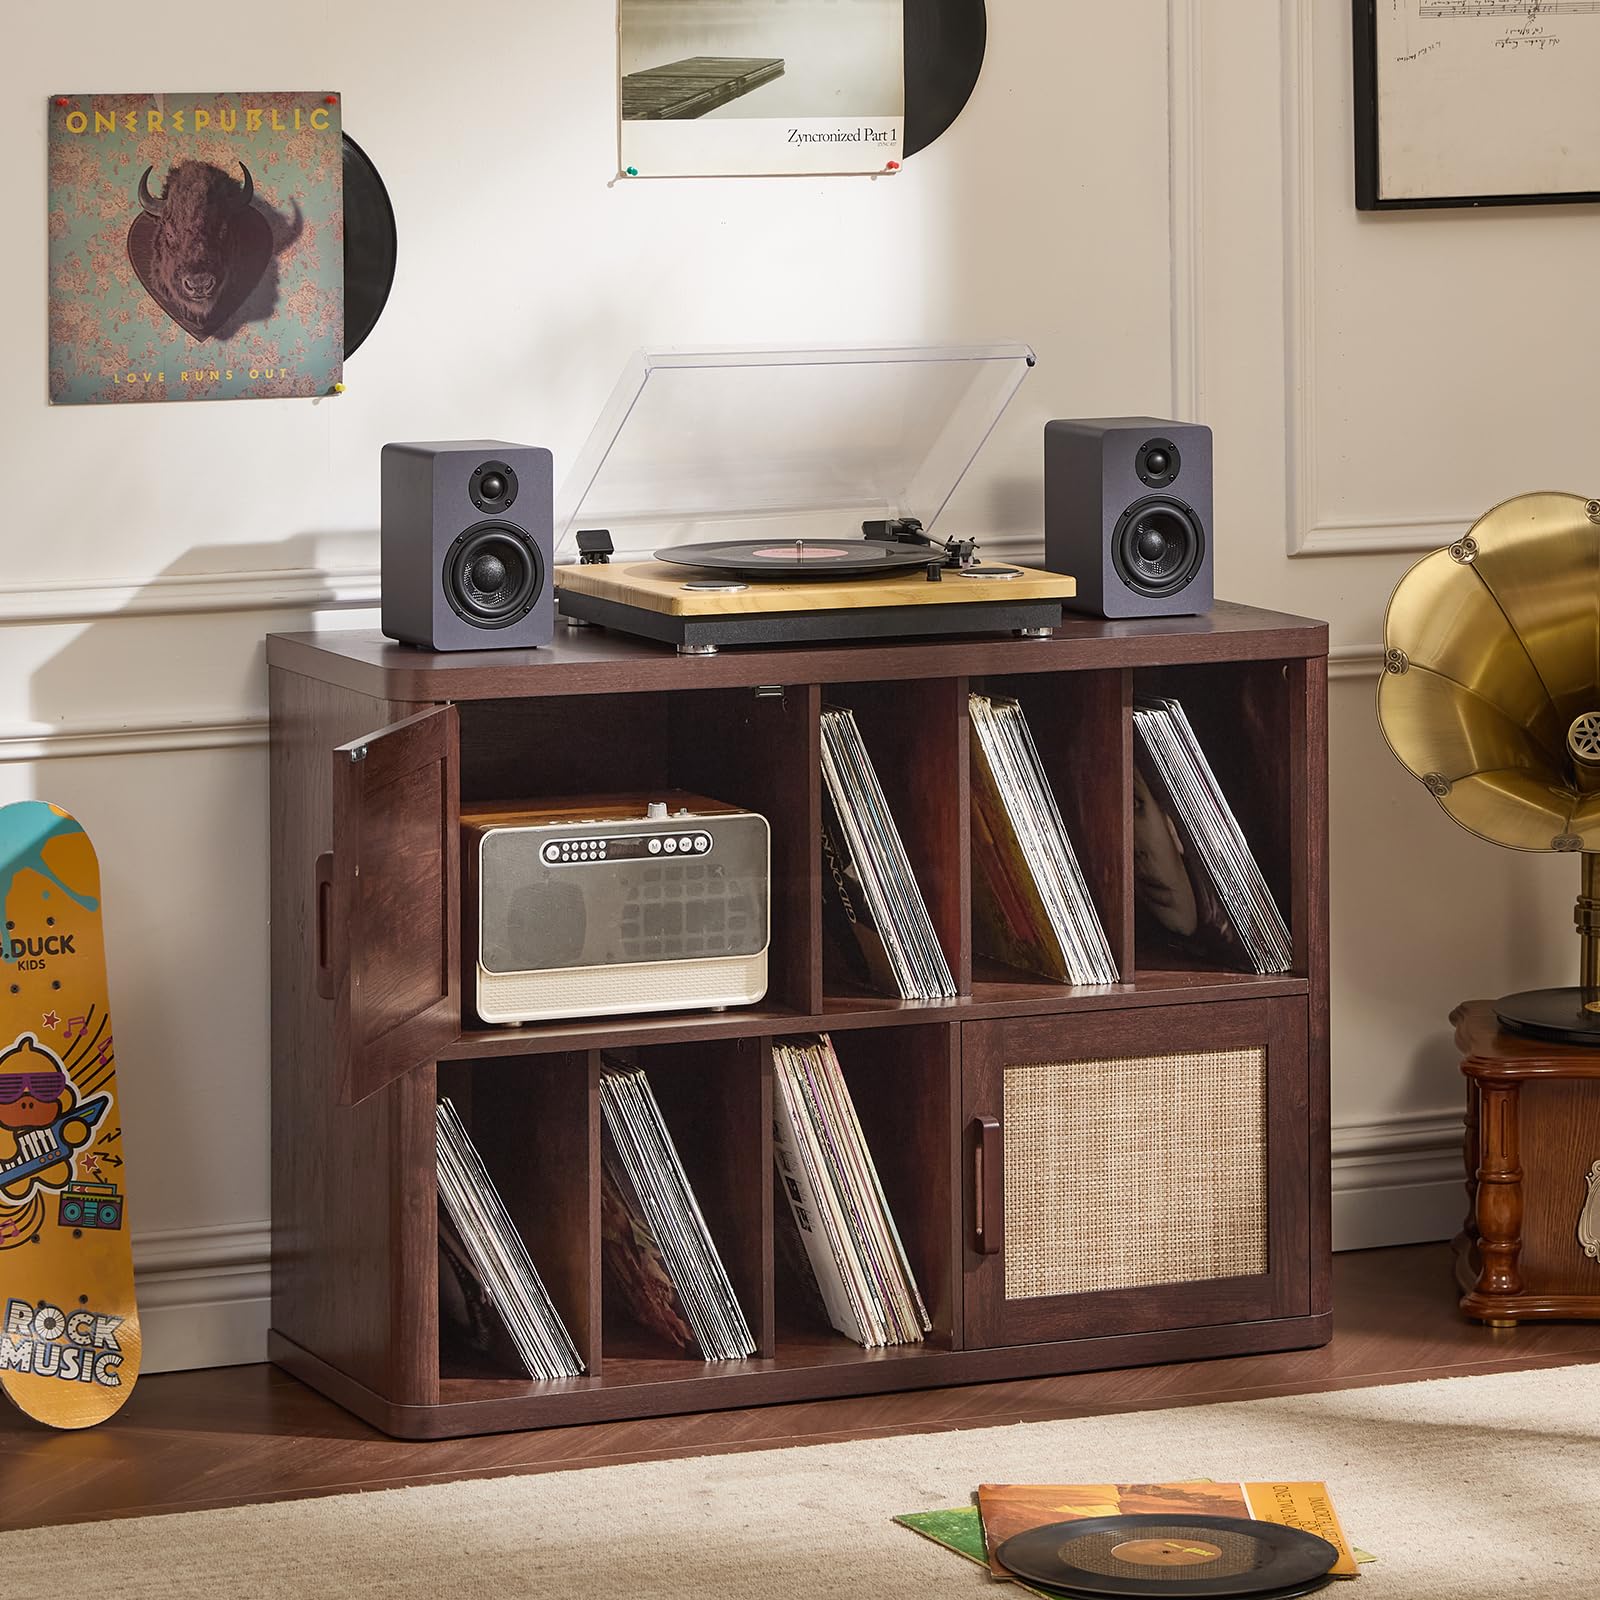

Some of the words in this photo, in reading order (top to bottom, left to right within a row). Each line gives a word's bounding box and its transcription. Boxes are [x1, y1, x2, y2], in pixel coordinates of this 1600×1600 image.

[66, 108, 330, 134] ONEREPUBLIC
[787, 128, 861, 147] Zyncronized
[864, 128, 888, 142] Part
[891, 128, 897, 142] 1
[114, 372, 165, 384] LOVE
[181, 370, 233, 382] RUNS
[250, 368, 287, 380] OUT
[0, 934, 76, 959] .DUCK
[17, 960, 46, 971] KIDS
[6, 1299, 124, 1352] ROCK
[0, 1335, 124, 1387] MUSIC
